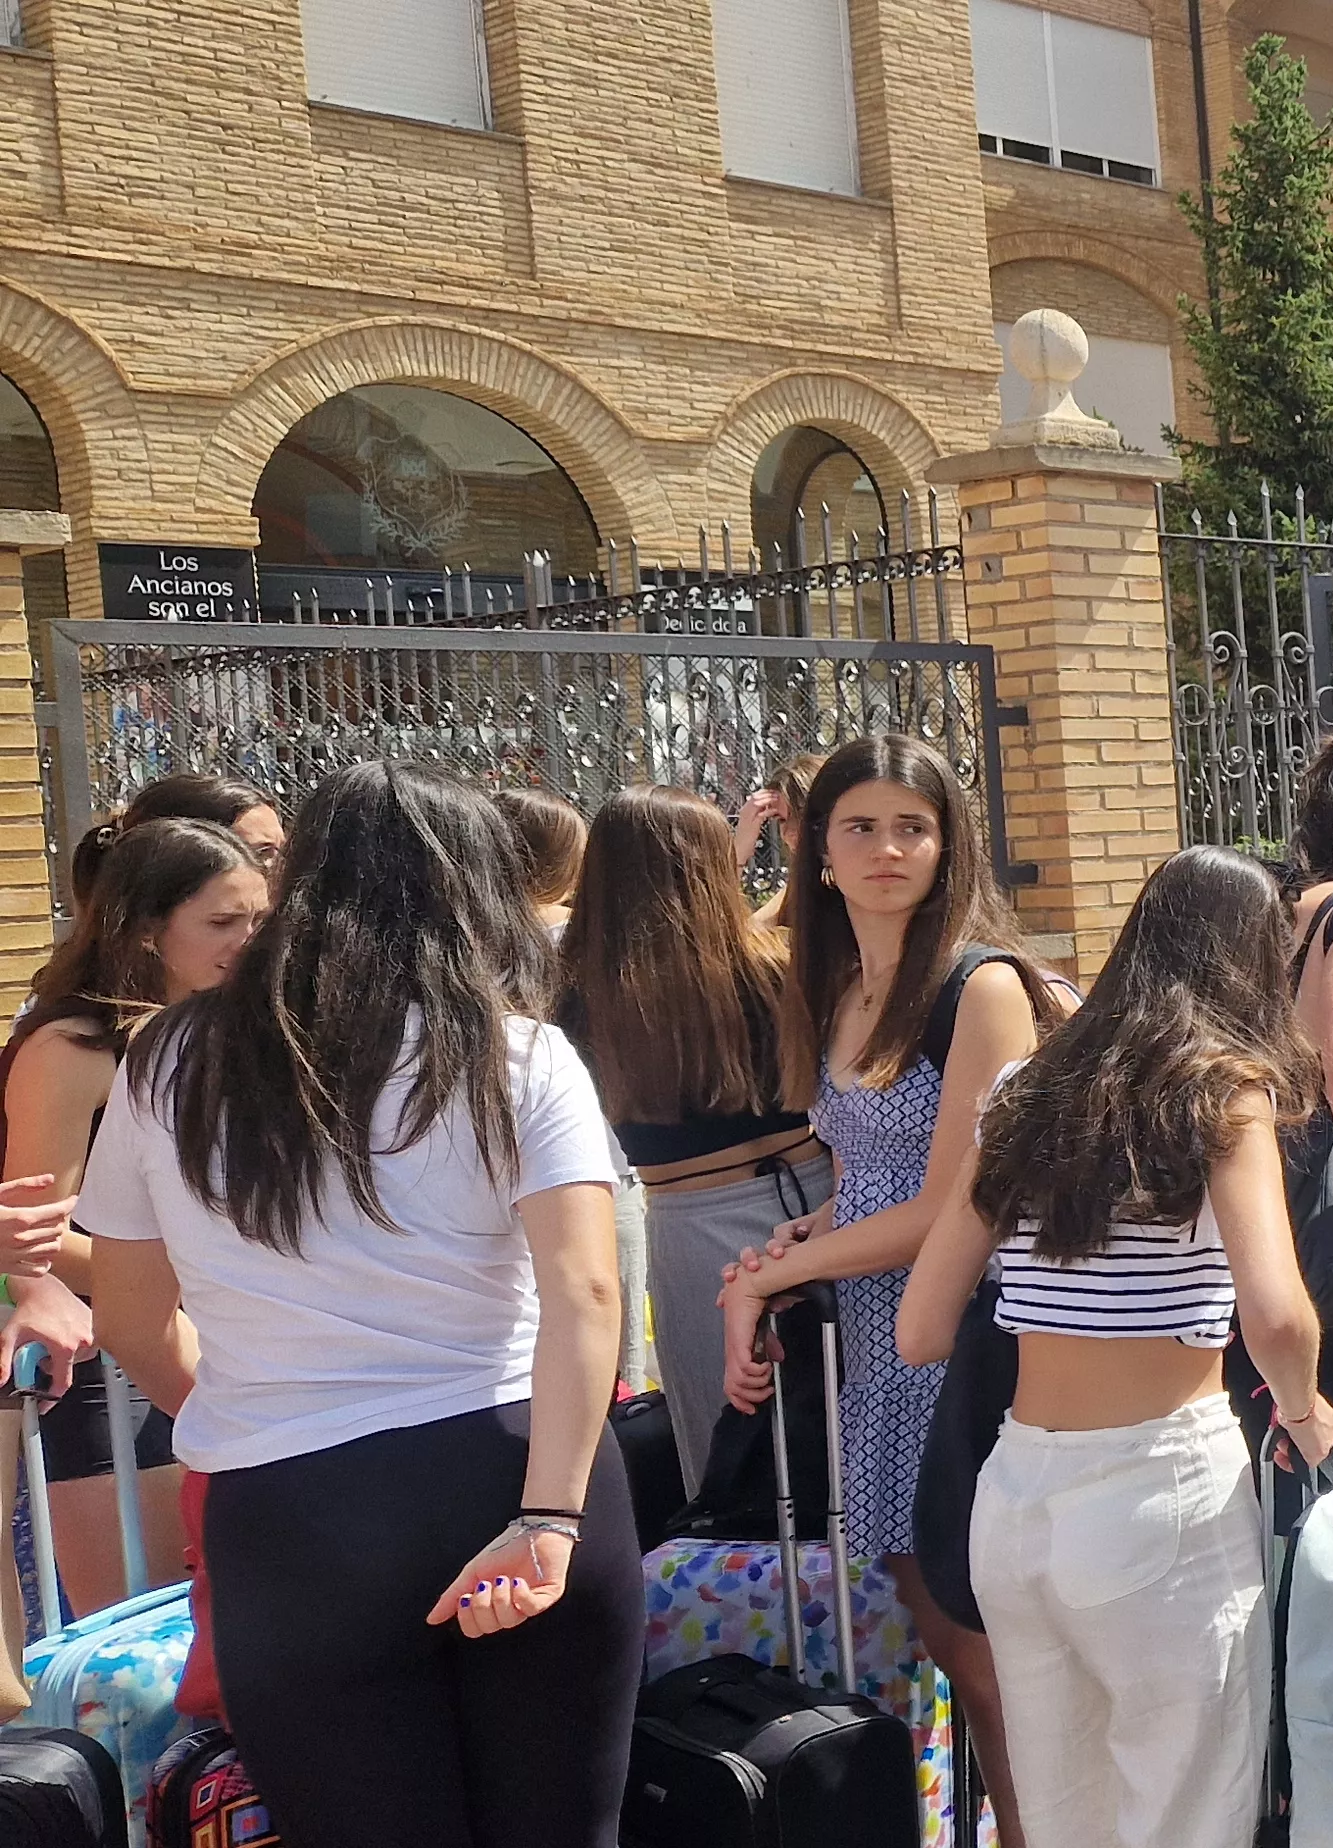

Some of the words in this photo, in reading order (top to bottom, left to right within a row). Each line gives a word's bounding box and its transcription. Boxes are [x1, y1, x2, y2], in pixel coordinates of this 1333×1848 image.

[159, 550, 199, 572] Los
[127, 574, 234, 597] Ancianos
[148, 600, 190, 618] son
[195, 598, 216, 618] el
